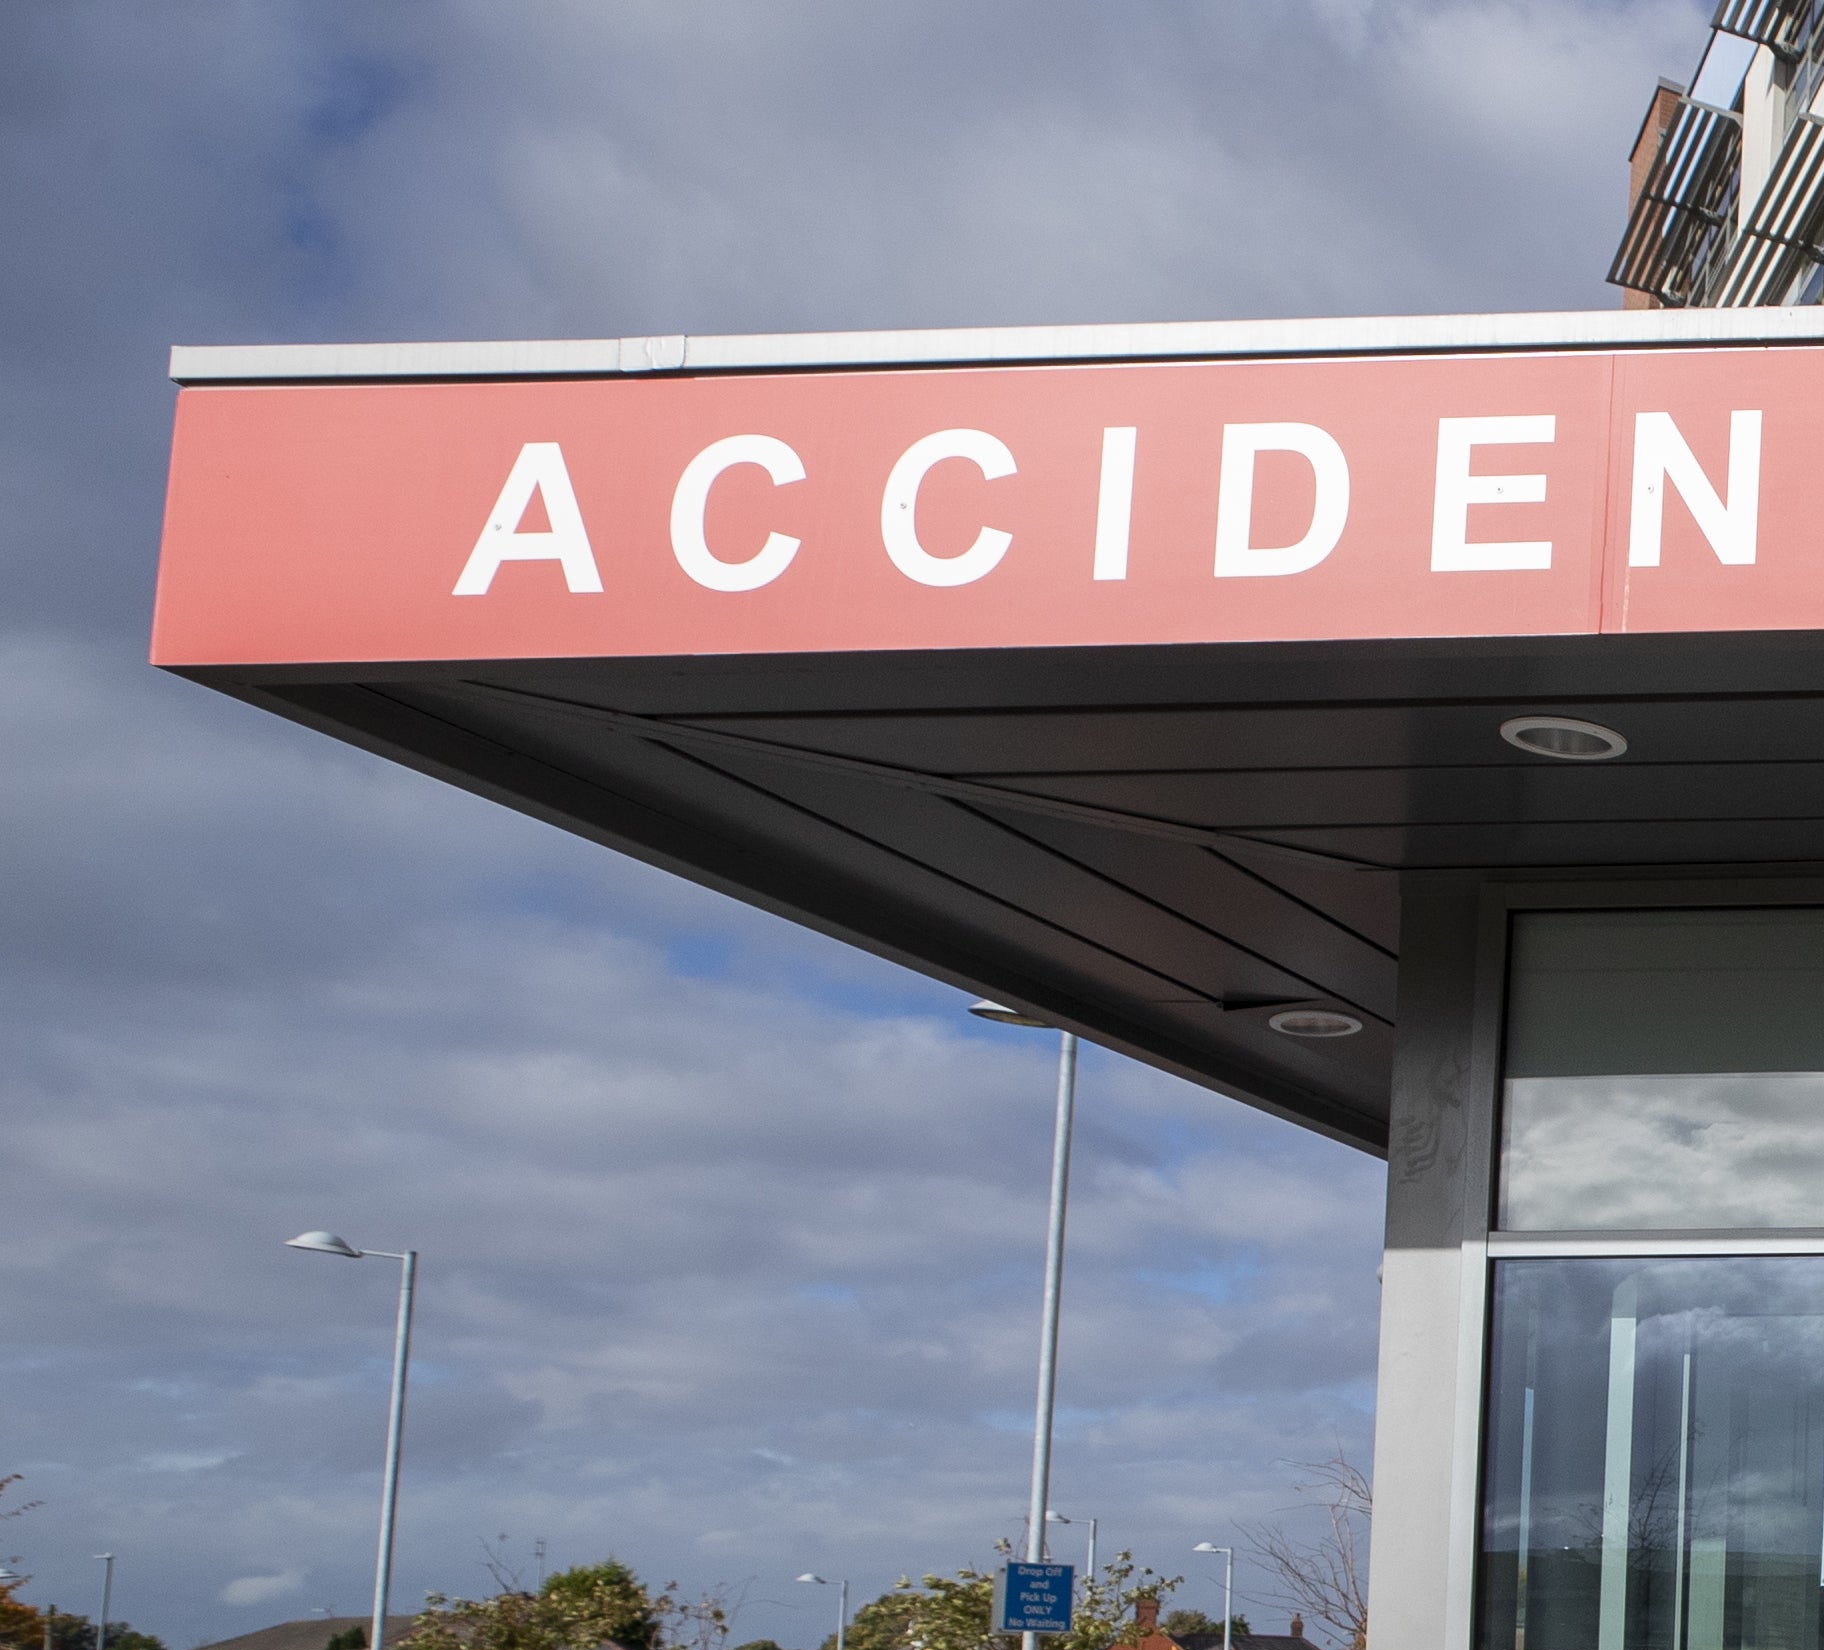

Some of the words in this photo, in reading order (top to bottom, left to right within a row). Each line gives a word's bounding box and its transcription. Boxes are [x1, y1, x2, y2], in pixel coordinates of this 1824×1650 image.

[1017, 1567, 1043, 1577] Drop
[1045, 1567, 1063, 1576] Off
[1029, 1580, 1050, 1589] and
[1020, 1592, 1040, 1602] Pick
[1042, 1594, 1057, 1604] Up
[1023, 1605, 1053, 1615] ONLY
[1008, 1618, 1024, 1627] No
[1025, 1618, 1066, 1629] Waiting
